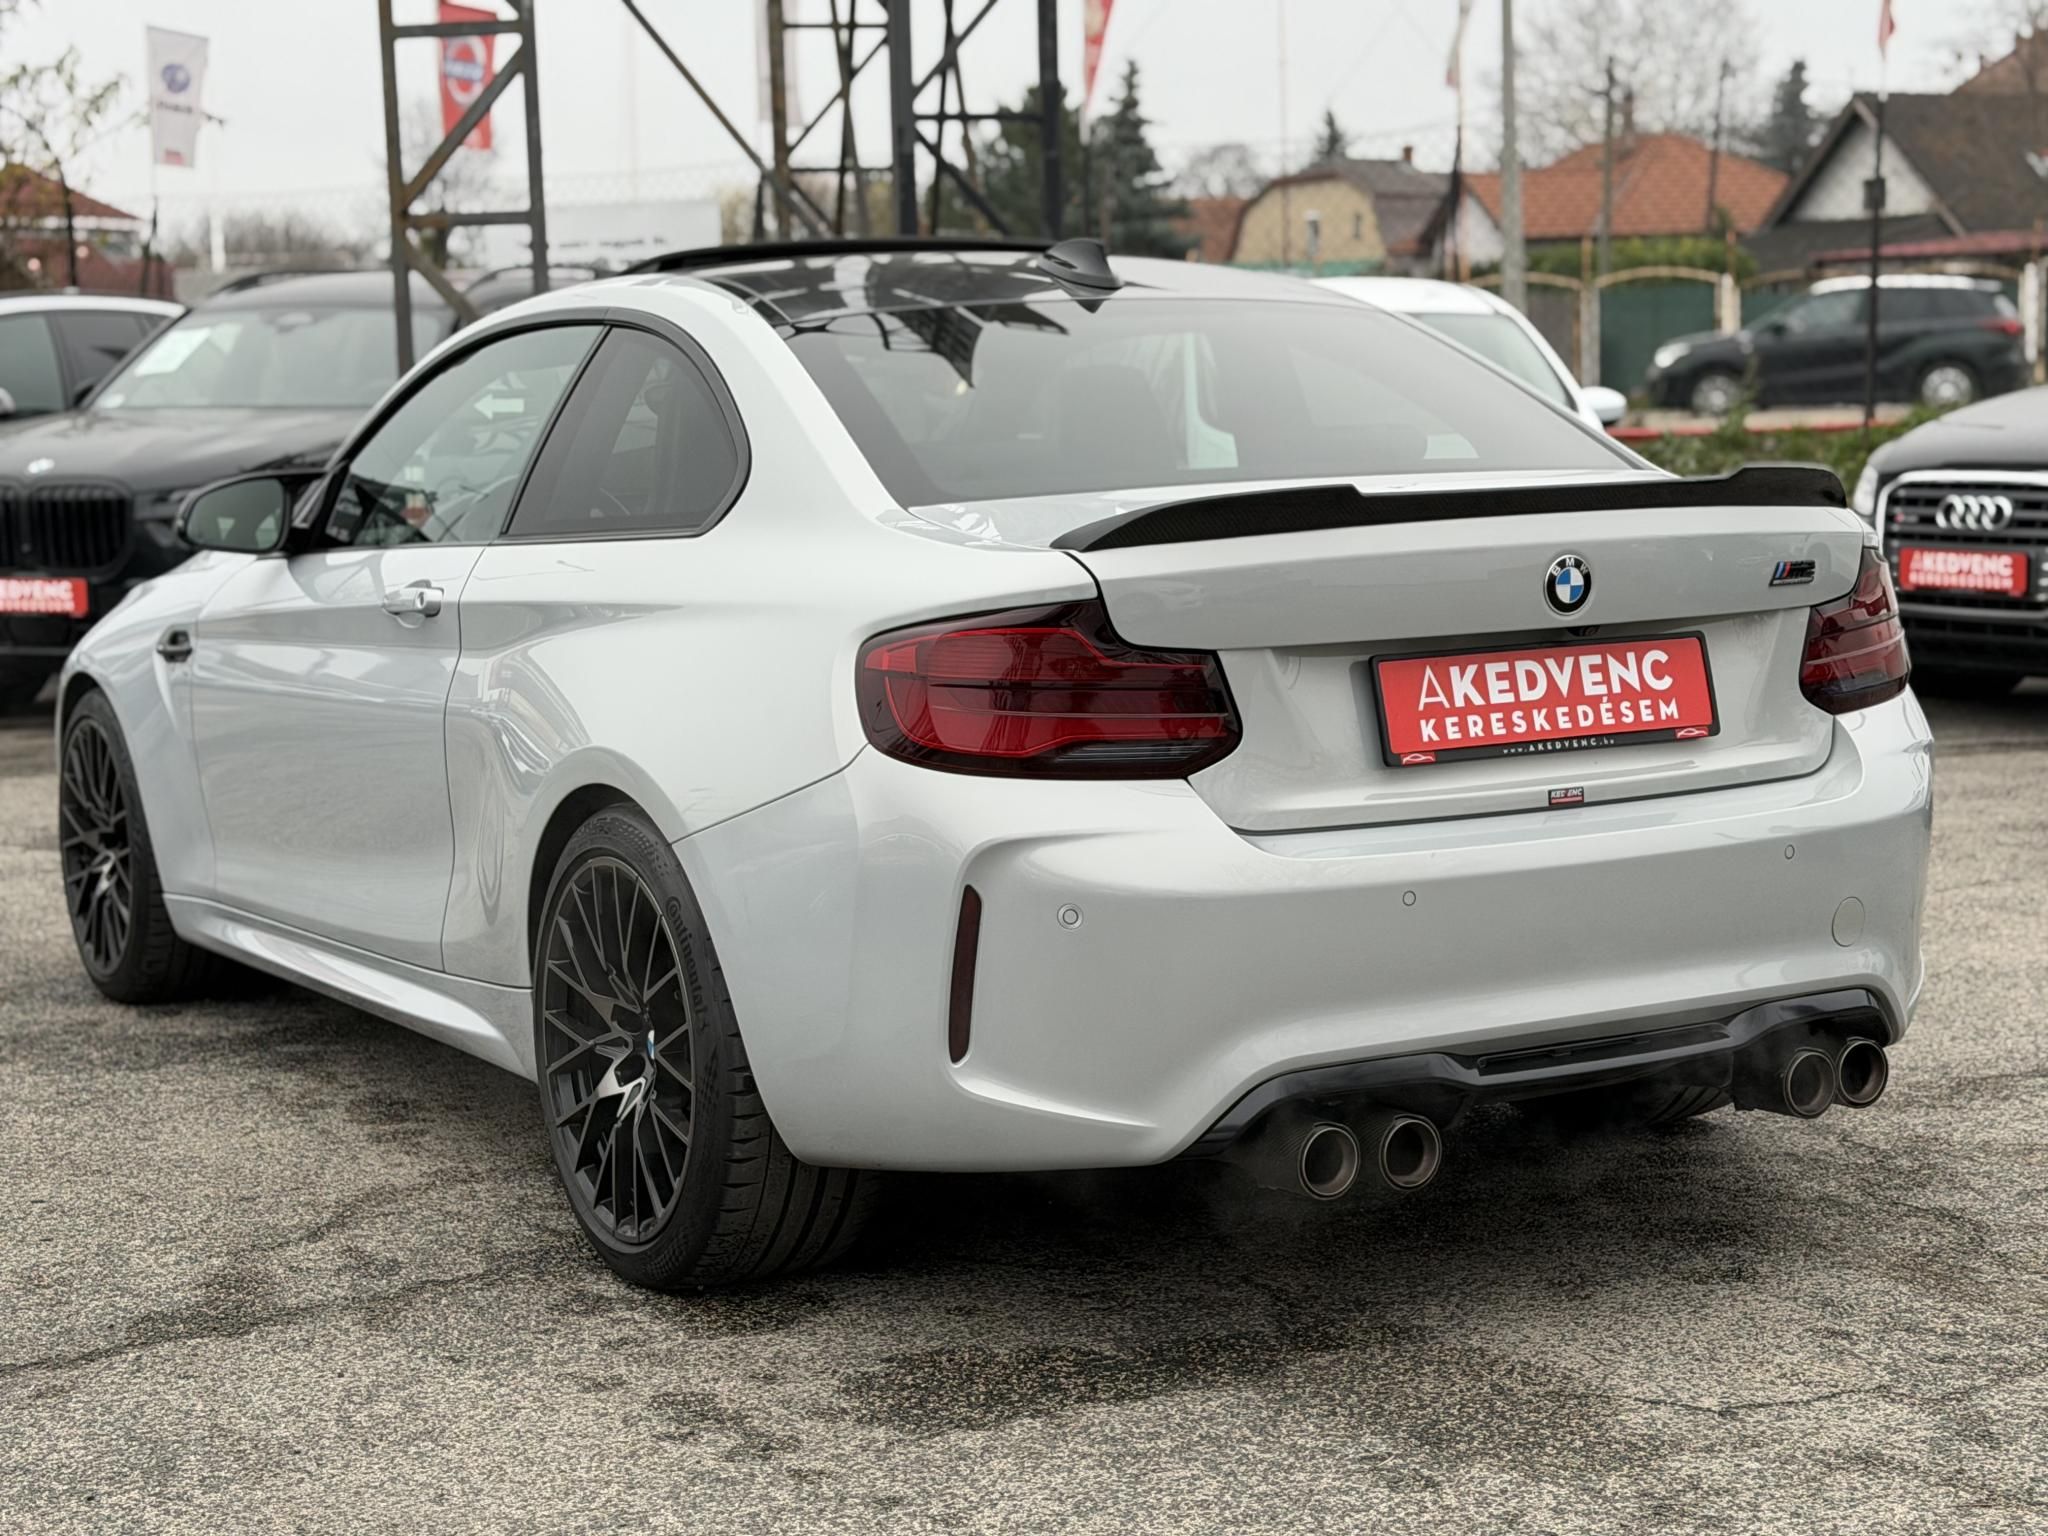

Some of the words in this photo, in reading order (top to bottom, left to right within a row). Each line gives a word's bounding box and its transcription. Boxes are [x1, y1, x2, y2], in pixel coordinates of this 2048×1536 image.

[1551, 556, 1588, 576] BMW
[1417, 649, 1674, 712] AKEDVENC
[1419, 696, 1680, 743] KERESKEDÉSEM
[665, 896, 709, 1015] Continental
